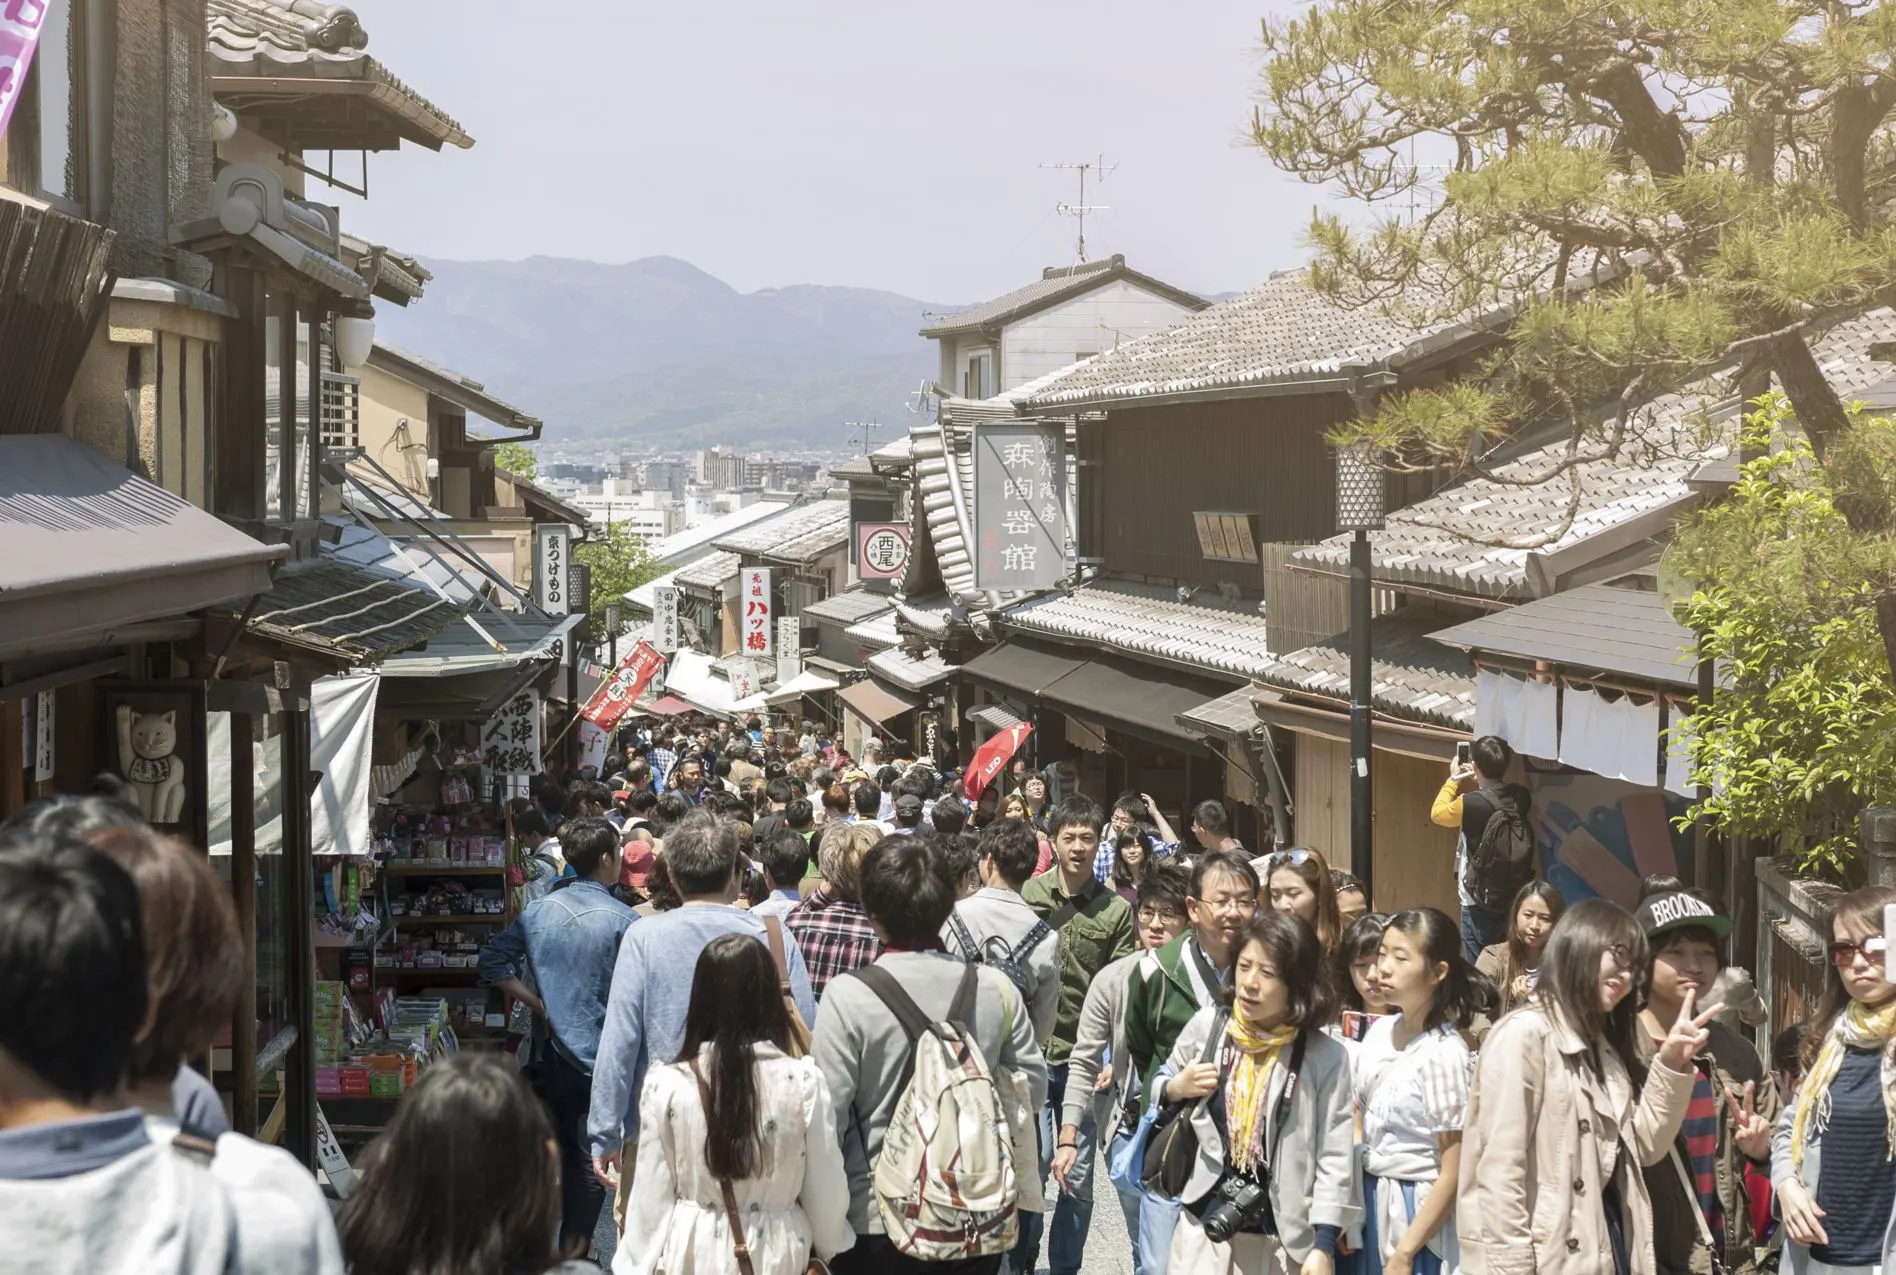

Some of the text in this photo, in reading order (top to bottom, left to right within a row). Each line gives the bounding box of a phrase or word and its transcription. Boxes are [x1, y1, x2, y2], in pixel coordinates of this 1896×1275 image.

[1000, 441, 1038, 572] 森陶器館
[547, 535, 561, 604] 京つけもの
[877, 535, 895, 567] 西尾
[484, 706, 509, 773] 人形
[508, 692, 536, 773] 西陣織
[1284, 1071, 1297, 1099] Canon
